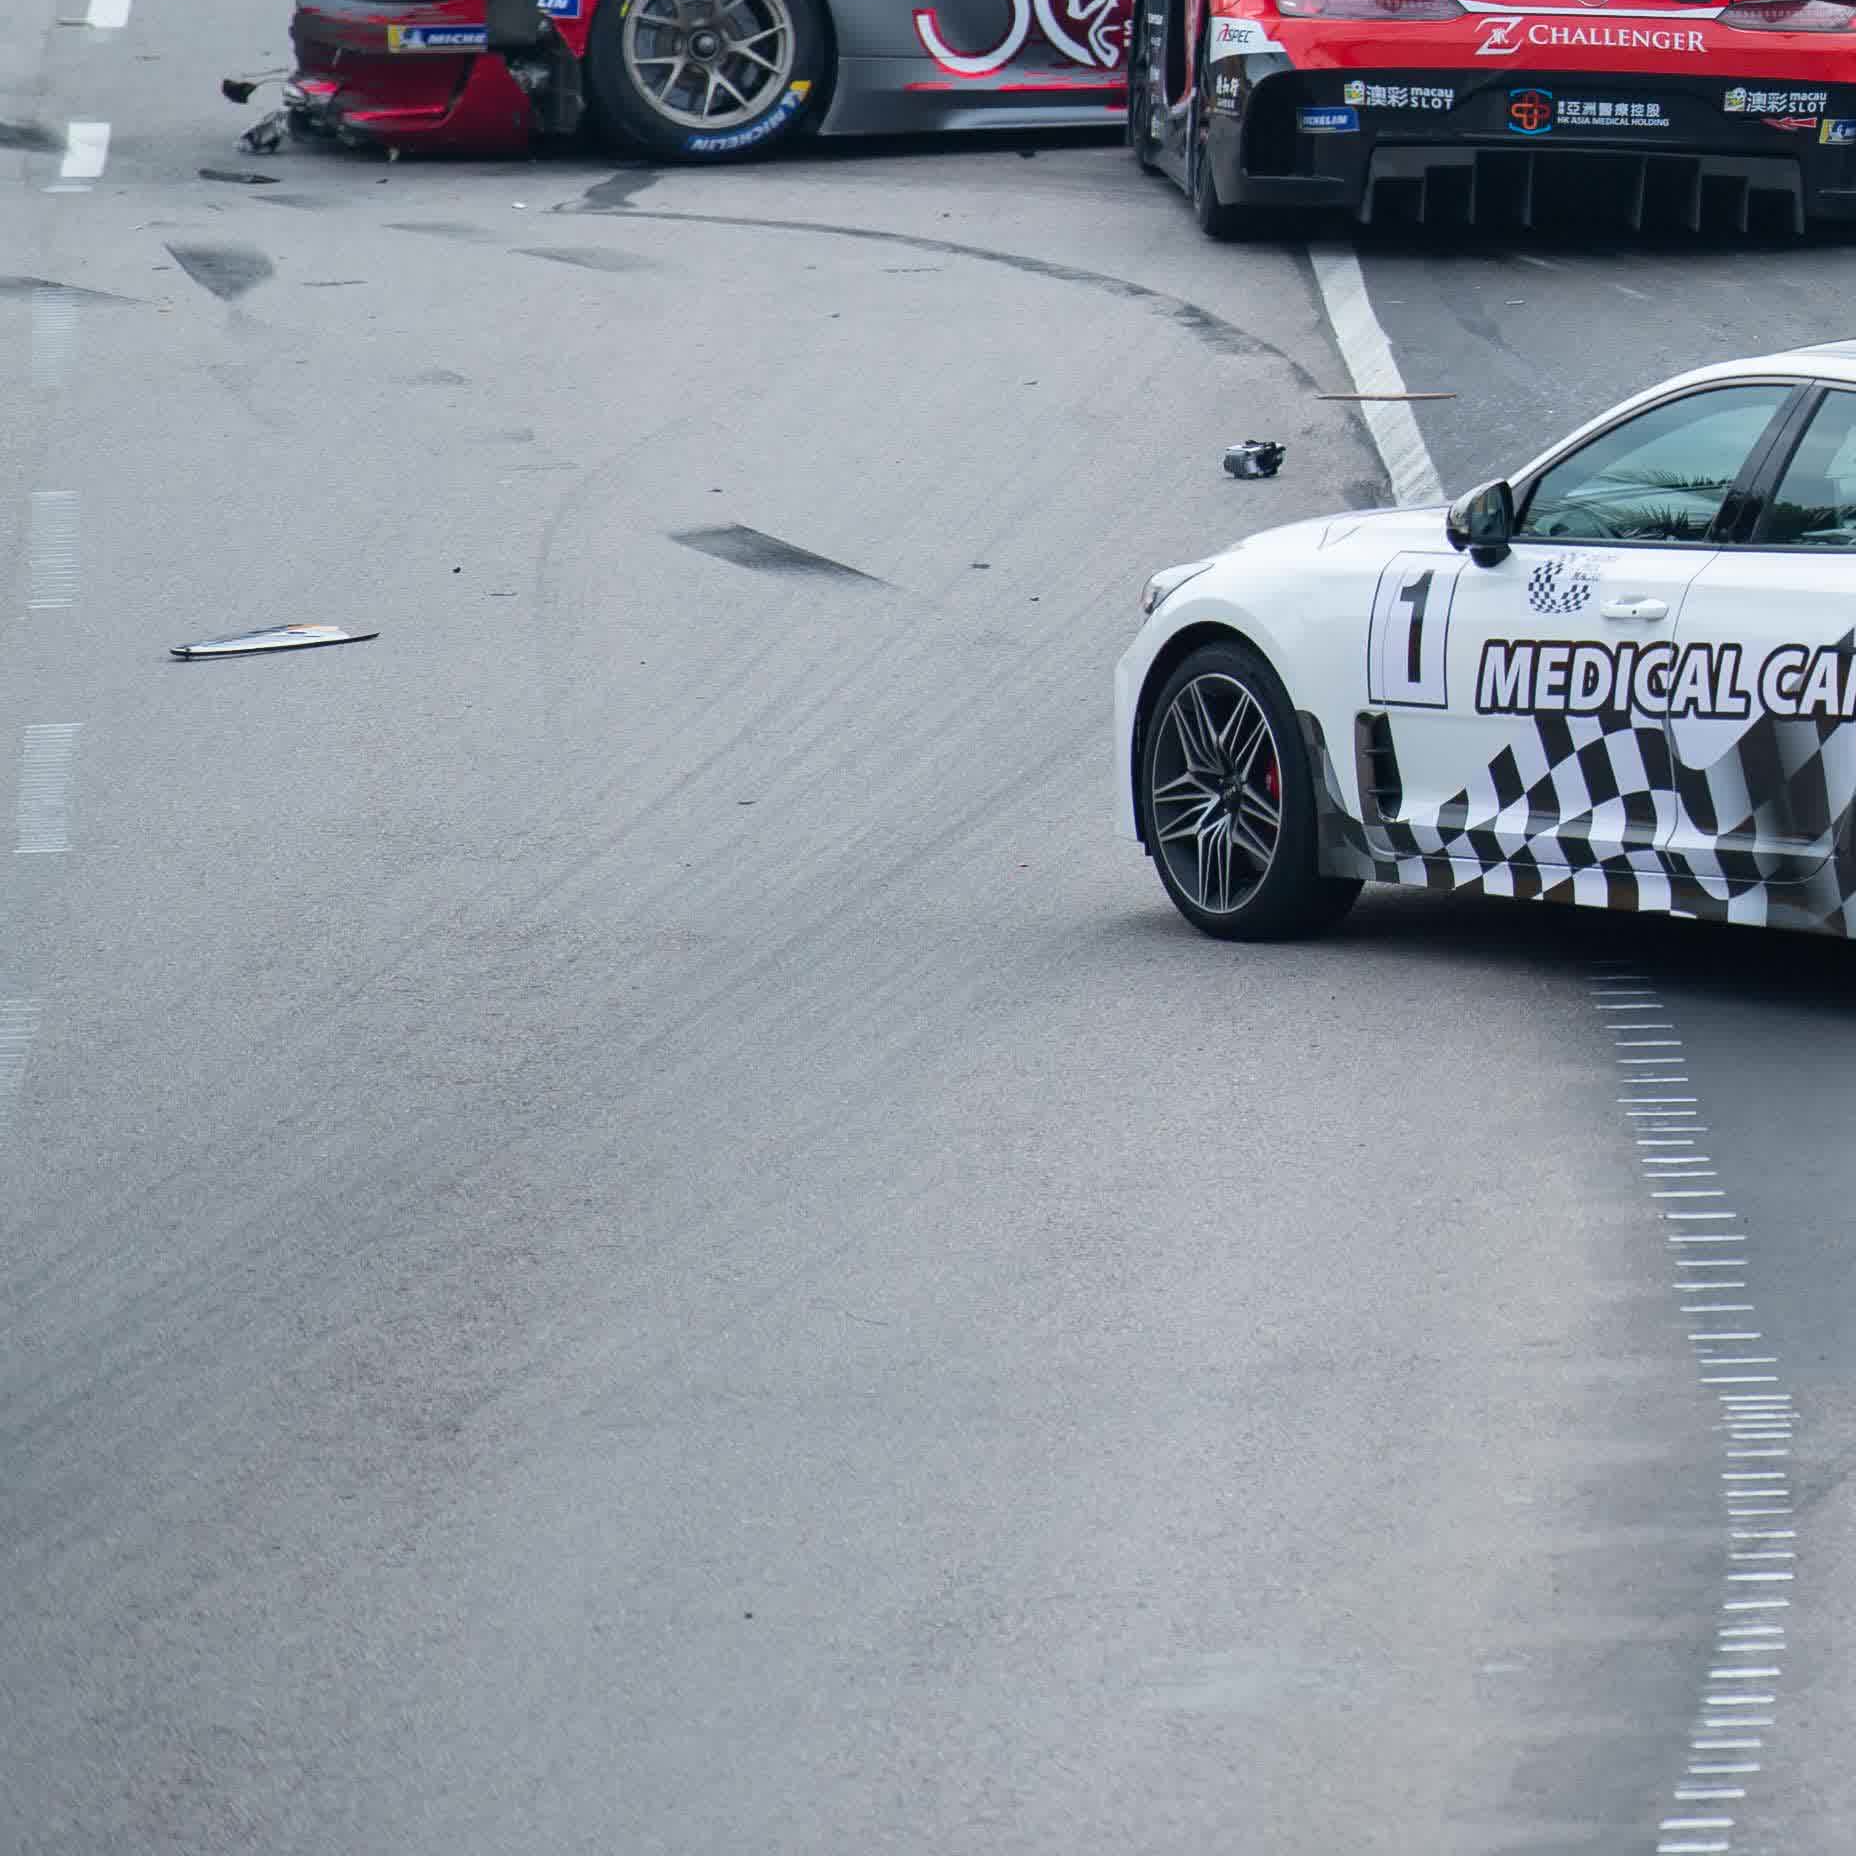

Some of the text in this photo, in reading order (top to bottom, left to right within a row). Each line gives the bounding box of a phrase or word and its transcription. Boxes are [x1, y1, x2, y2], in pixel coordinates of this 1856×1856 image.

[427, 32, 487, 44] MICHE
[1528, 24, 1708, 53] CHALLENGER
[1366, 85, 1408, 107] 澳彩
[1410, 87, 1454, 98] macau
[1789, 92, 1828, 101] macau
[1410, 97, 1454, 110] SLOT
[1747, 91, 1787, 112] 澳彩
[1789, 101, 1827, 112] SLOT
[1592, 118, 1630, 126] MEDICAL
[1632, 119, 1670, 127] HOLDING
[1400, 570, 1434, 683] 1
[1475, 640, 1751, 720] MEDICAL
